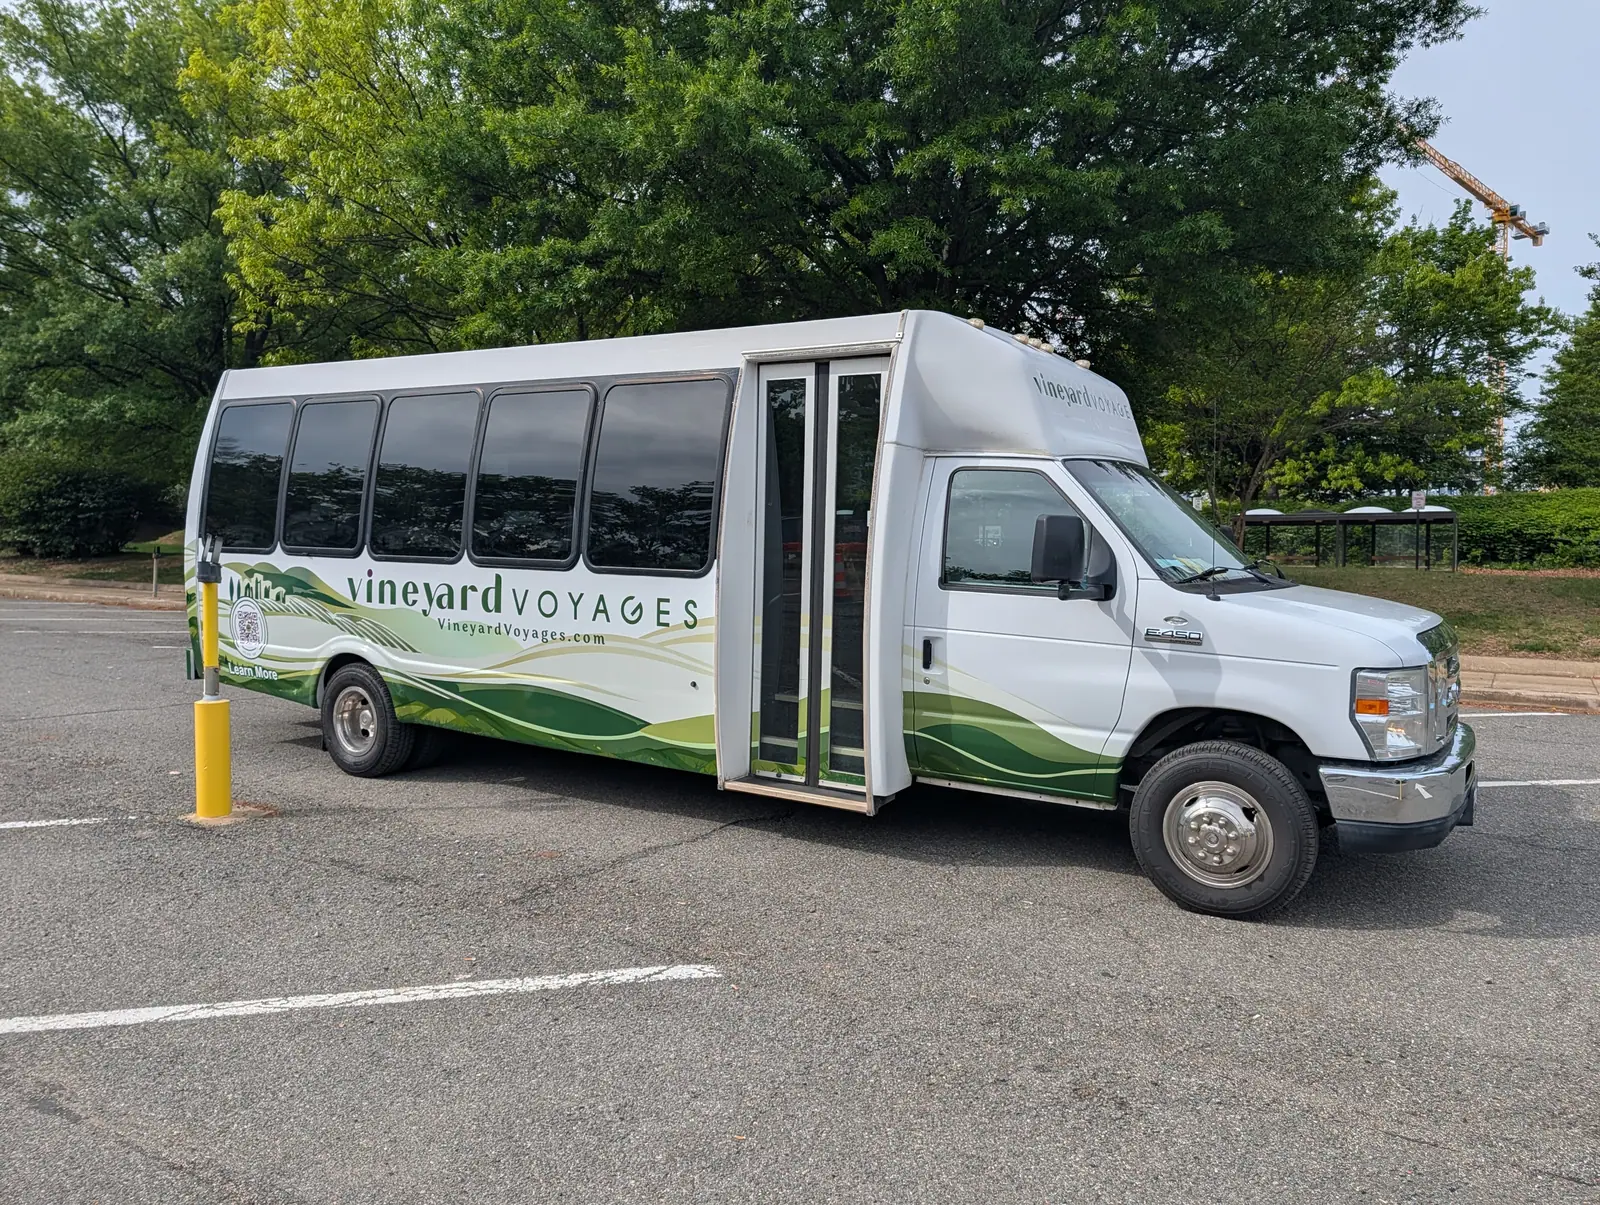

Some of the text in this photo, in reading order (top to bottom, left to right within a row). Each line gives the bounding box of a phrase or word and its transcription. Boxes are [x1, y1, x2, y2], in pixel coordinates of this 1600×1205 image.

[1033, 373, 1091, 407] vineyard
[346, 568, 698, 630] vineyard VOYAGES
[437, 617, 606, 645] VineyardVoyages.com
[228, 662, 278, 680] Learn More
